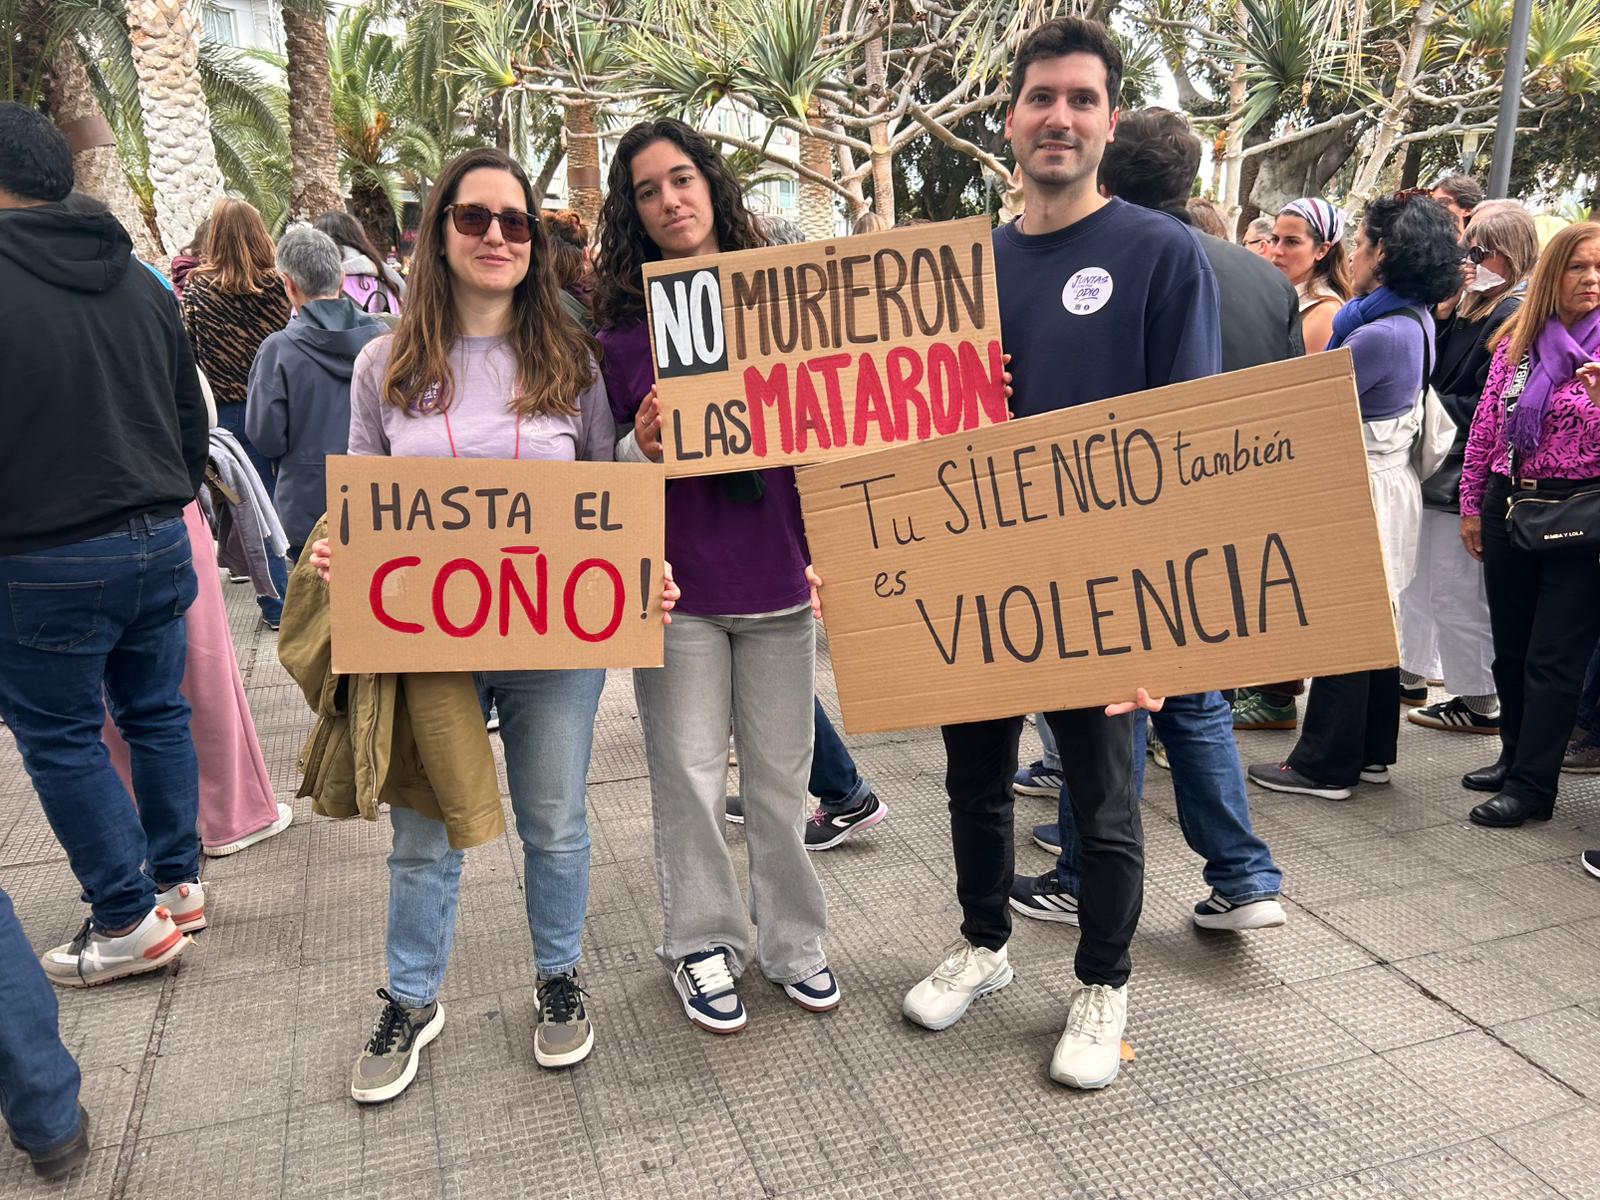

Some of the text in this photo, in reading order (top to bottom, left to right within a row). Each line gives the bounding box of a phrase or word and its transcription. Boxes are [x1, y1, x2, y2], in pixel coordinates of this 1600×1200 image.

[650, 270, 724, 368] NO
[1072, 275, 1109, 288] JUNTAS
[1077, 288, 1099, 297] ODIO
[672, 340, 1008, 461] LAS MATARON
[339, 482, 623, 546] ¡HASTA EL
[840, 473, 926, 549] Tu
[1172, 429, 1296, 487] también
[369, 545, 652, 643] COÑO!
[873, 568, 908, 598] es
[915, 532, 1310, 665] VIOLENCIA
